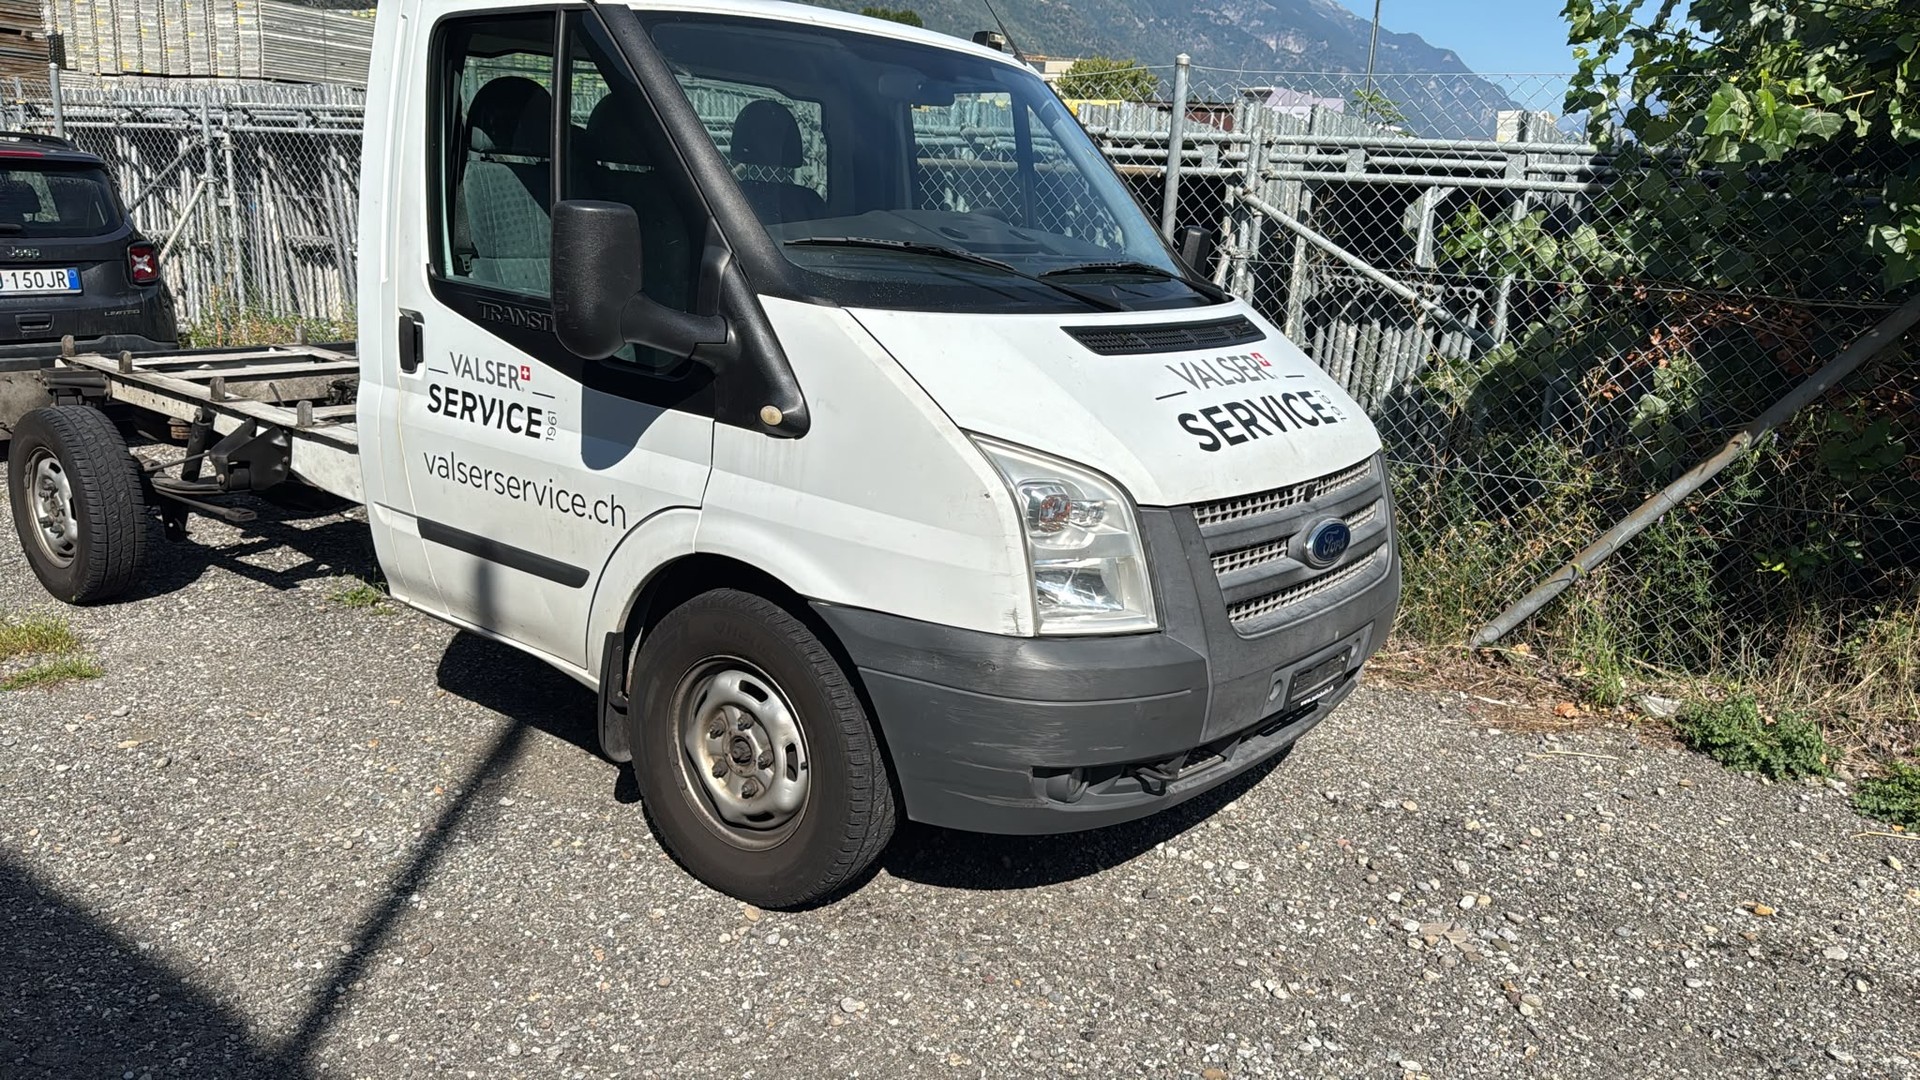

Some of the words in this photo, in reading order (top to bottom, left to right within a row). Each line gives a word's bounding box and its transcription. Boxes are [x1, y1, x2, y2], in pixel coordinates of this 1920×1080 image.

[7, 247, 40, 259] Jeep
[450, 351, 521, 391] VALSER
[1165, 355, 1275, 391] VALSER
[427, 383, 543, 439] SERVICE
[545, 410, 557, 442] 1961
[1178, 390, 1338, 452] SERVICE
[424, 451, 626, 529] valserservice.ch
[1323, 530, 1346, 555] Ford
